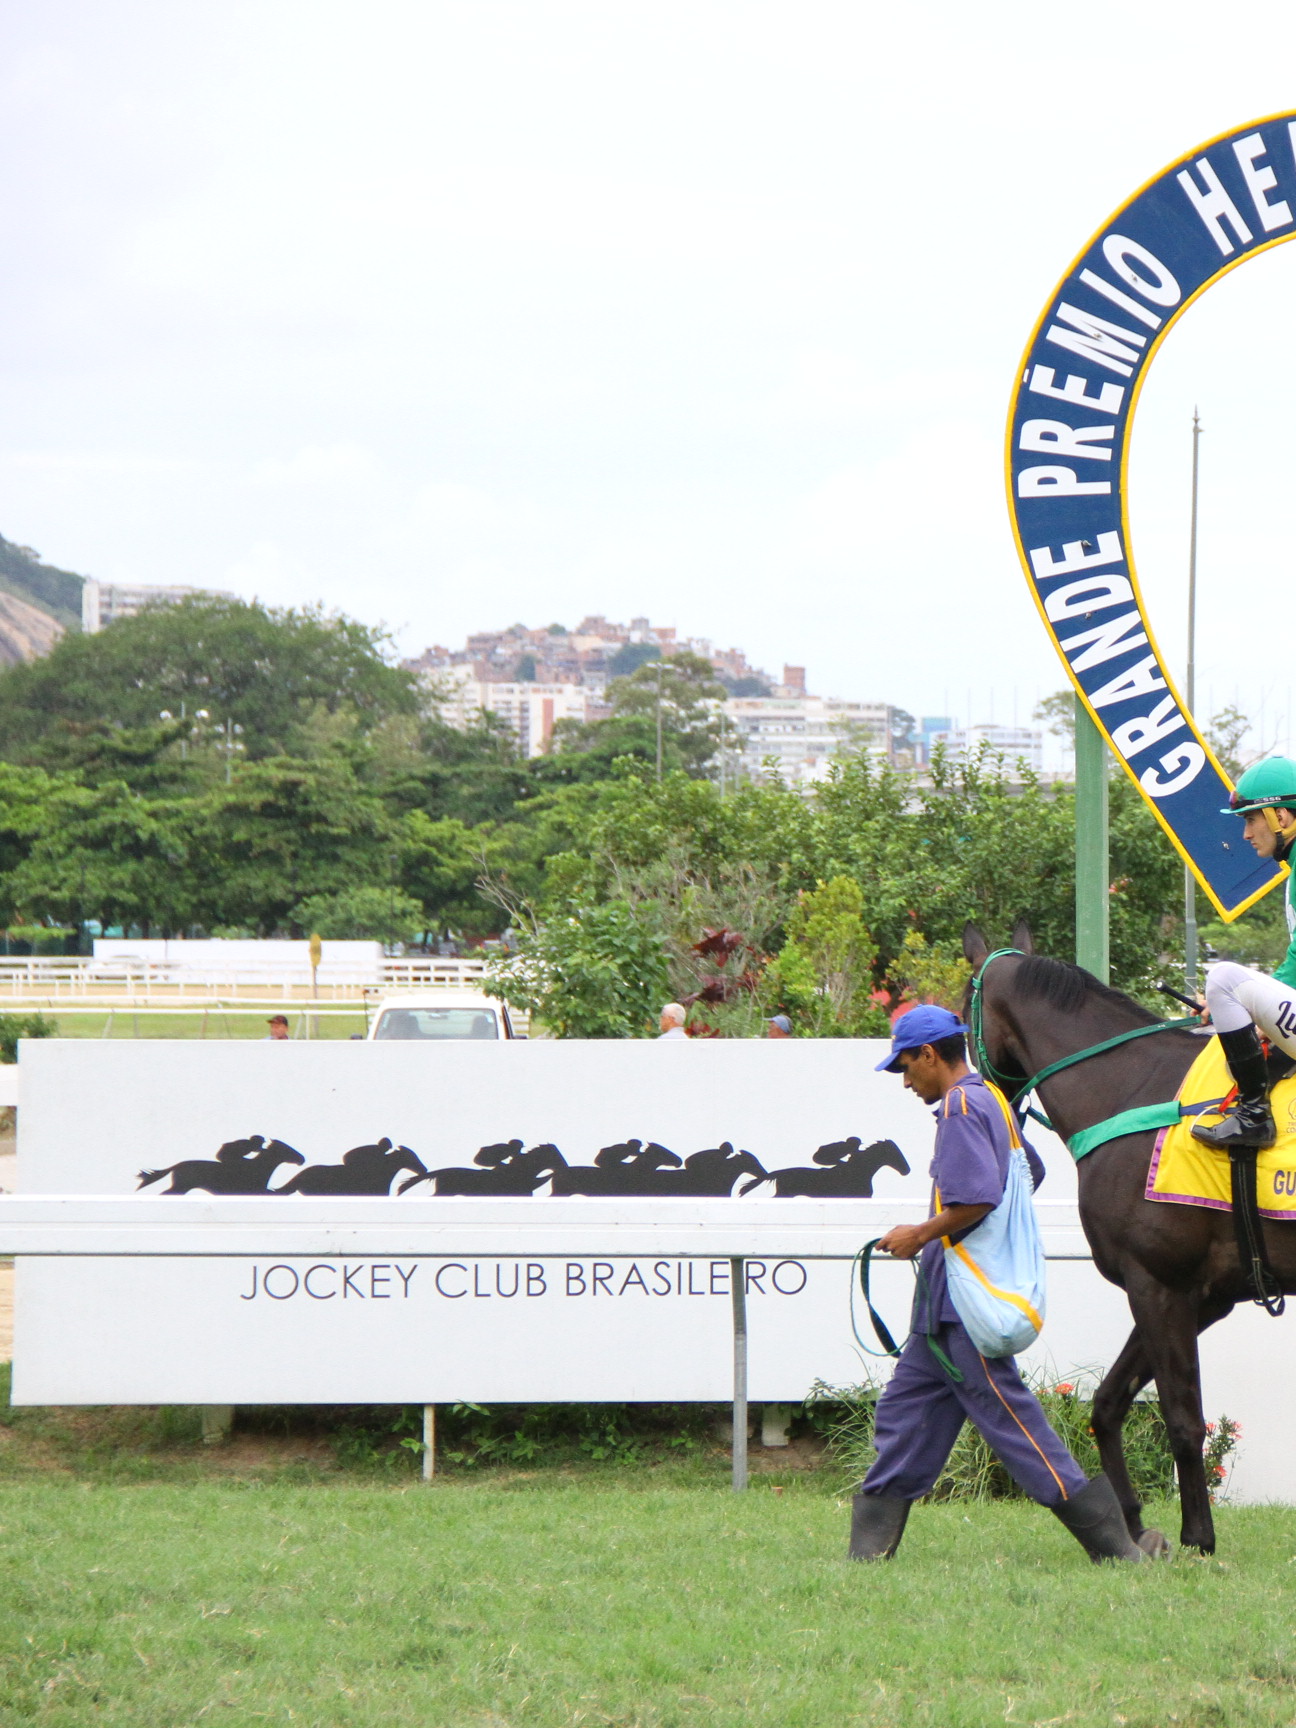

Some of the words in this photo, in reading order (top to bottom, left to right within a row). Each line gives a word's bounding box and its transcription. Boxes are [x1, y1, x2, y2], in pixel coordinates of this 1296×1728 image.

[1030, 530, 1206, 798] GRANDE
[240, 1263, 418, 1300] JOCKEY
[434, 1262, 548, 1299] CLUB
[565, 1259, 808, 1297] BRASILERO
